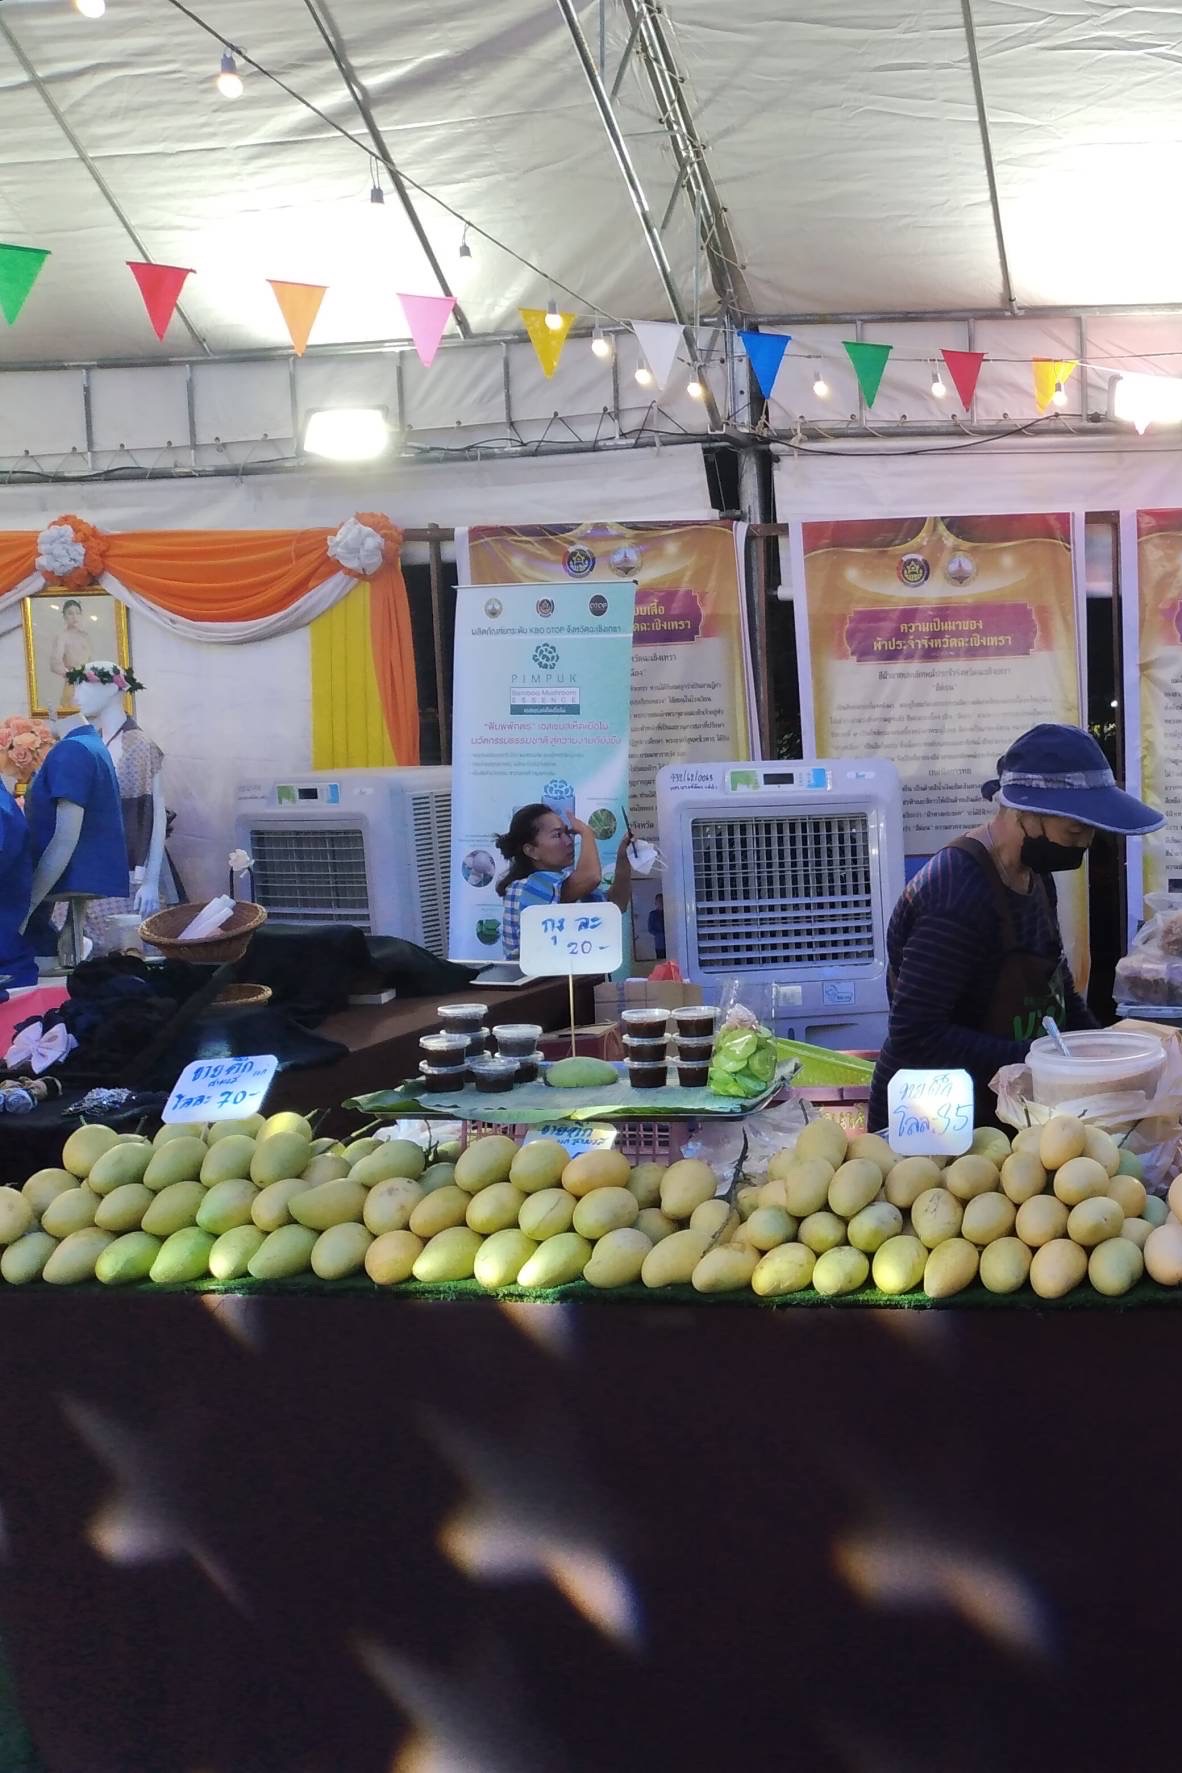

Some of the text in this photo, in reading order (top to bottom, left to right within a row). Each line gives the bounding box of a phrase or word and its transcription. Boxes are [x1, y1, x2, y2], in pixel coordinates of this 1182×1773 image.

[900, 618, 983, 633] ความเป็นมาของ
[873, 633, 1012, 651] ผ้าประจำจังหวัดฉะเชิงเทรา
[511, 673, 577, 684] PIMPUK
